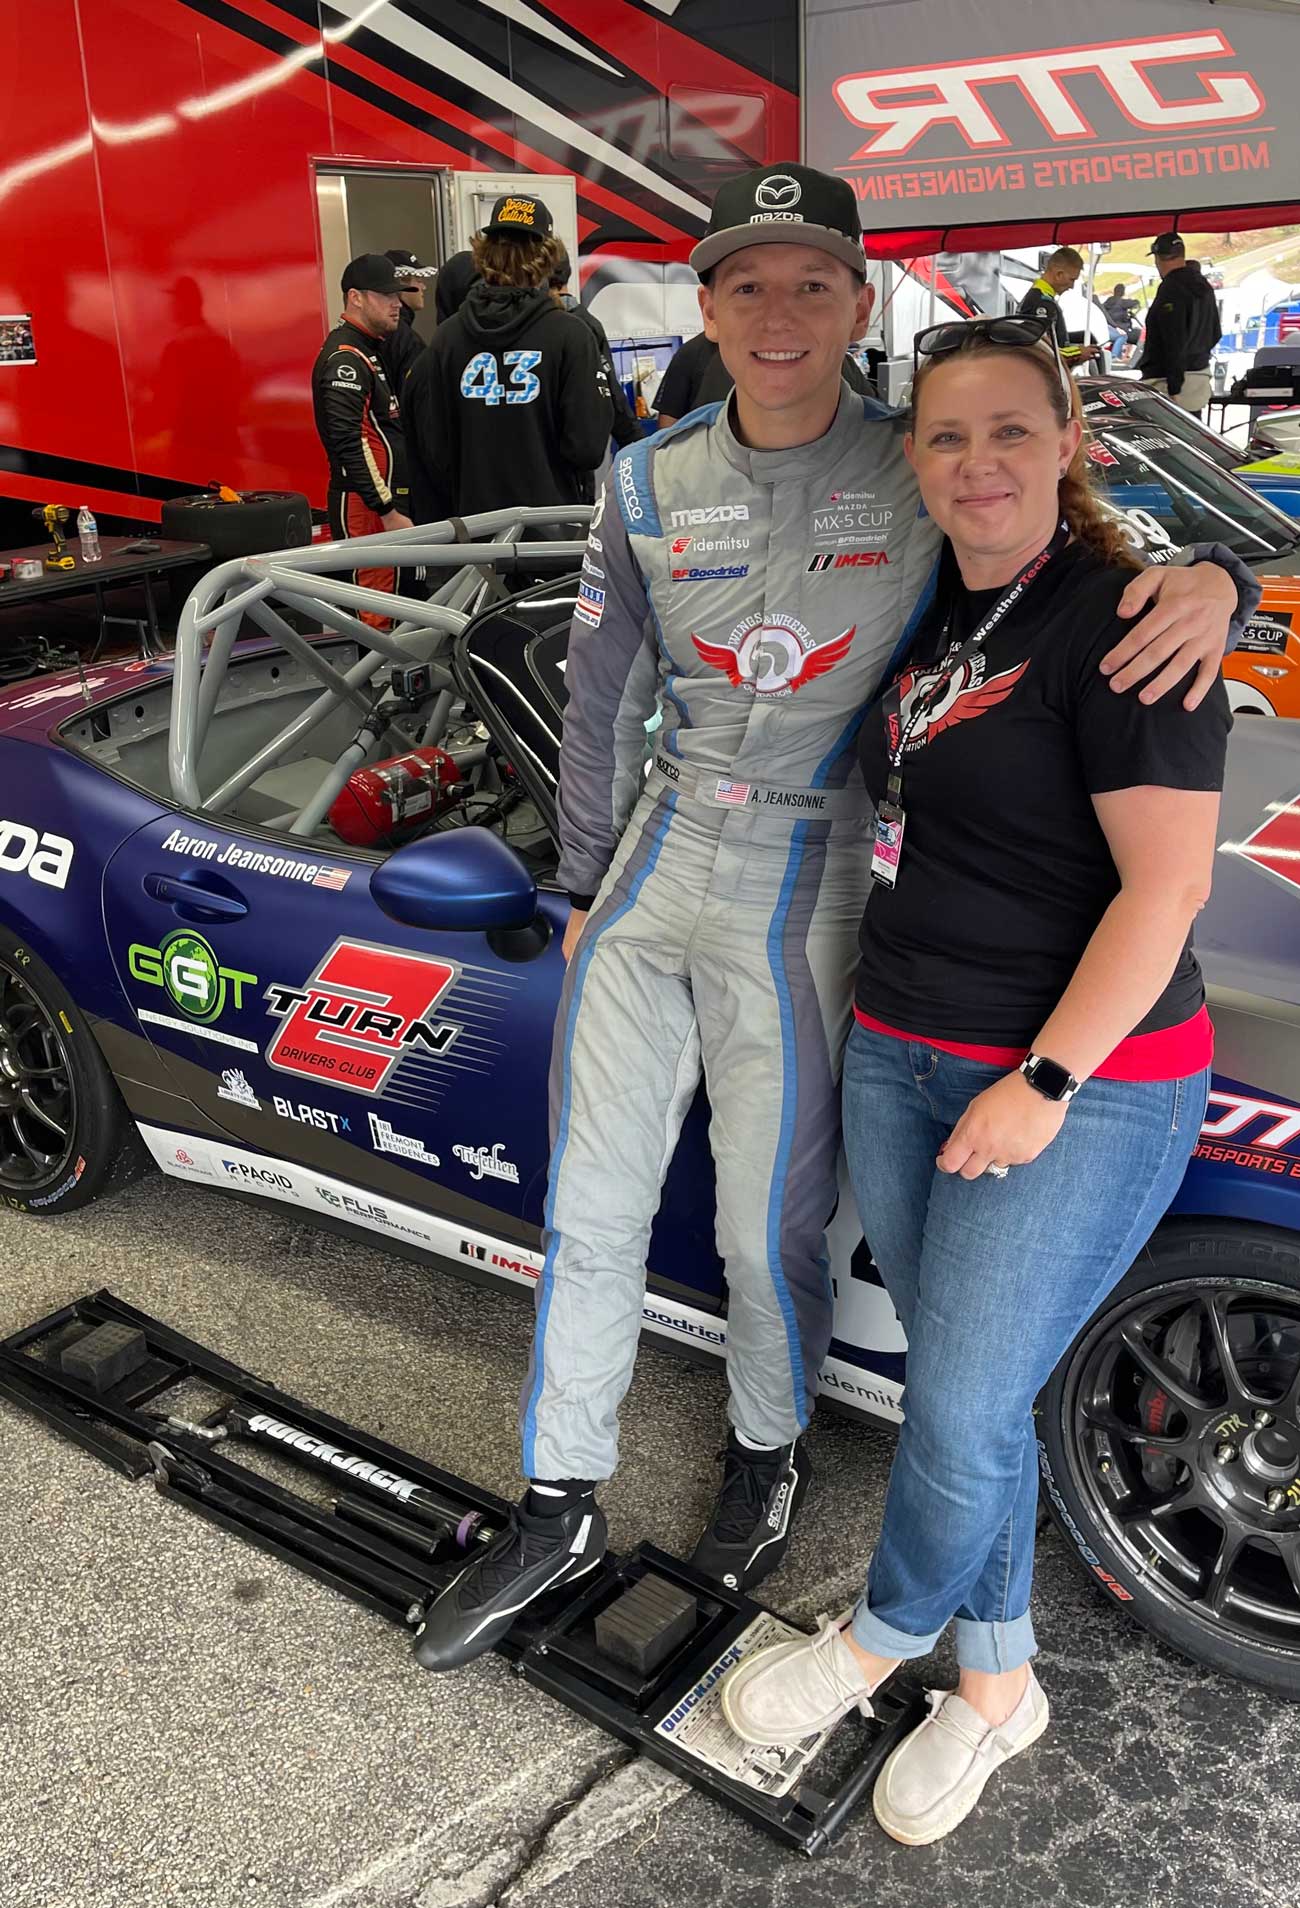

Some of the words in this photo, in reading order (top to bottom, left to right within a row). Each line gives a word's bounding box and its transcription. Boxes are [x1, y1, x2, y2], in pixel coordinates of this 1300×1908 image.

[505, 198, 536, 214] Speed
[750, 211, 804, 224] mazda
[461, 350, 542, 406] 43
[619, 456, 643, 523] sparco
[842, 491, 876, 500] idemitsu
[671, 504, 750, 528] mazda
[837, 503, 868, 511] MAZDA
[814, 514, 854, 533] MX-5
[857, 510, 893, 528] CUP
[693, 536, 750, 552] idemitsu
[672, 564, 750, 579] BFGoodrich
[833, 551, 892, 569] IMSA
[972, 551, 1051, 642] WeatherTech
[727, 612, 763, 647] WINGS
[772, 613, 817, 650] WHEELS
[1257, 630, 1283, 641] CUP
[657, 755, 680, 779] sparco
[751, 789, 762, 803] A.
[764, 790, 827, 810] JEANSONNE
[162, 829, 217, 860] Aaron
[217, 843, 318, 882] Jeansonne
[139, 1010, 180, 1029] ENERGY
[180, 1021, 237, 1045] SOLUTIONS
[268, 985, 458, 1053] TURN
[280, 1046, 337, 1070] DRIVERS
[338, 1060, 377, 1081] CLUB
[378, 1121, 391, 1132] 181
[1200, 1090, 1300, 1150] JT
[380, 1131, 424, 1151] FREMONT
[382, 1140, 439, 1165] RESIDENCES
[452, 1143, 518, 1180] Trefethen
[229, 1174, 300, 1198] RACING
[238, 1163, 293, 1189] PAGID
[341, 1195, 388, 1220] FLIS
[346, 1207, 431, 1242] PERFORMANCE
[491, 1254, 541, 1280] IMS
[1214, 1413, 1249, 1438] JTR
[248, 1414, 424, 1503] QUICKJACK
[767, 1482, 789, 1530] sparco
[660, 1645, 743, 1733] QUICKJACK
